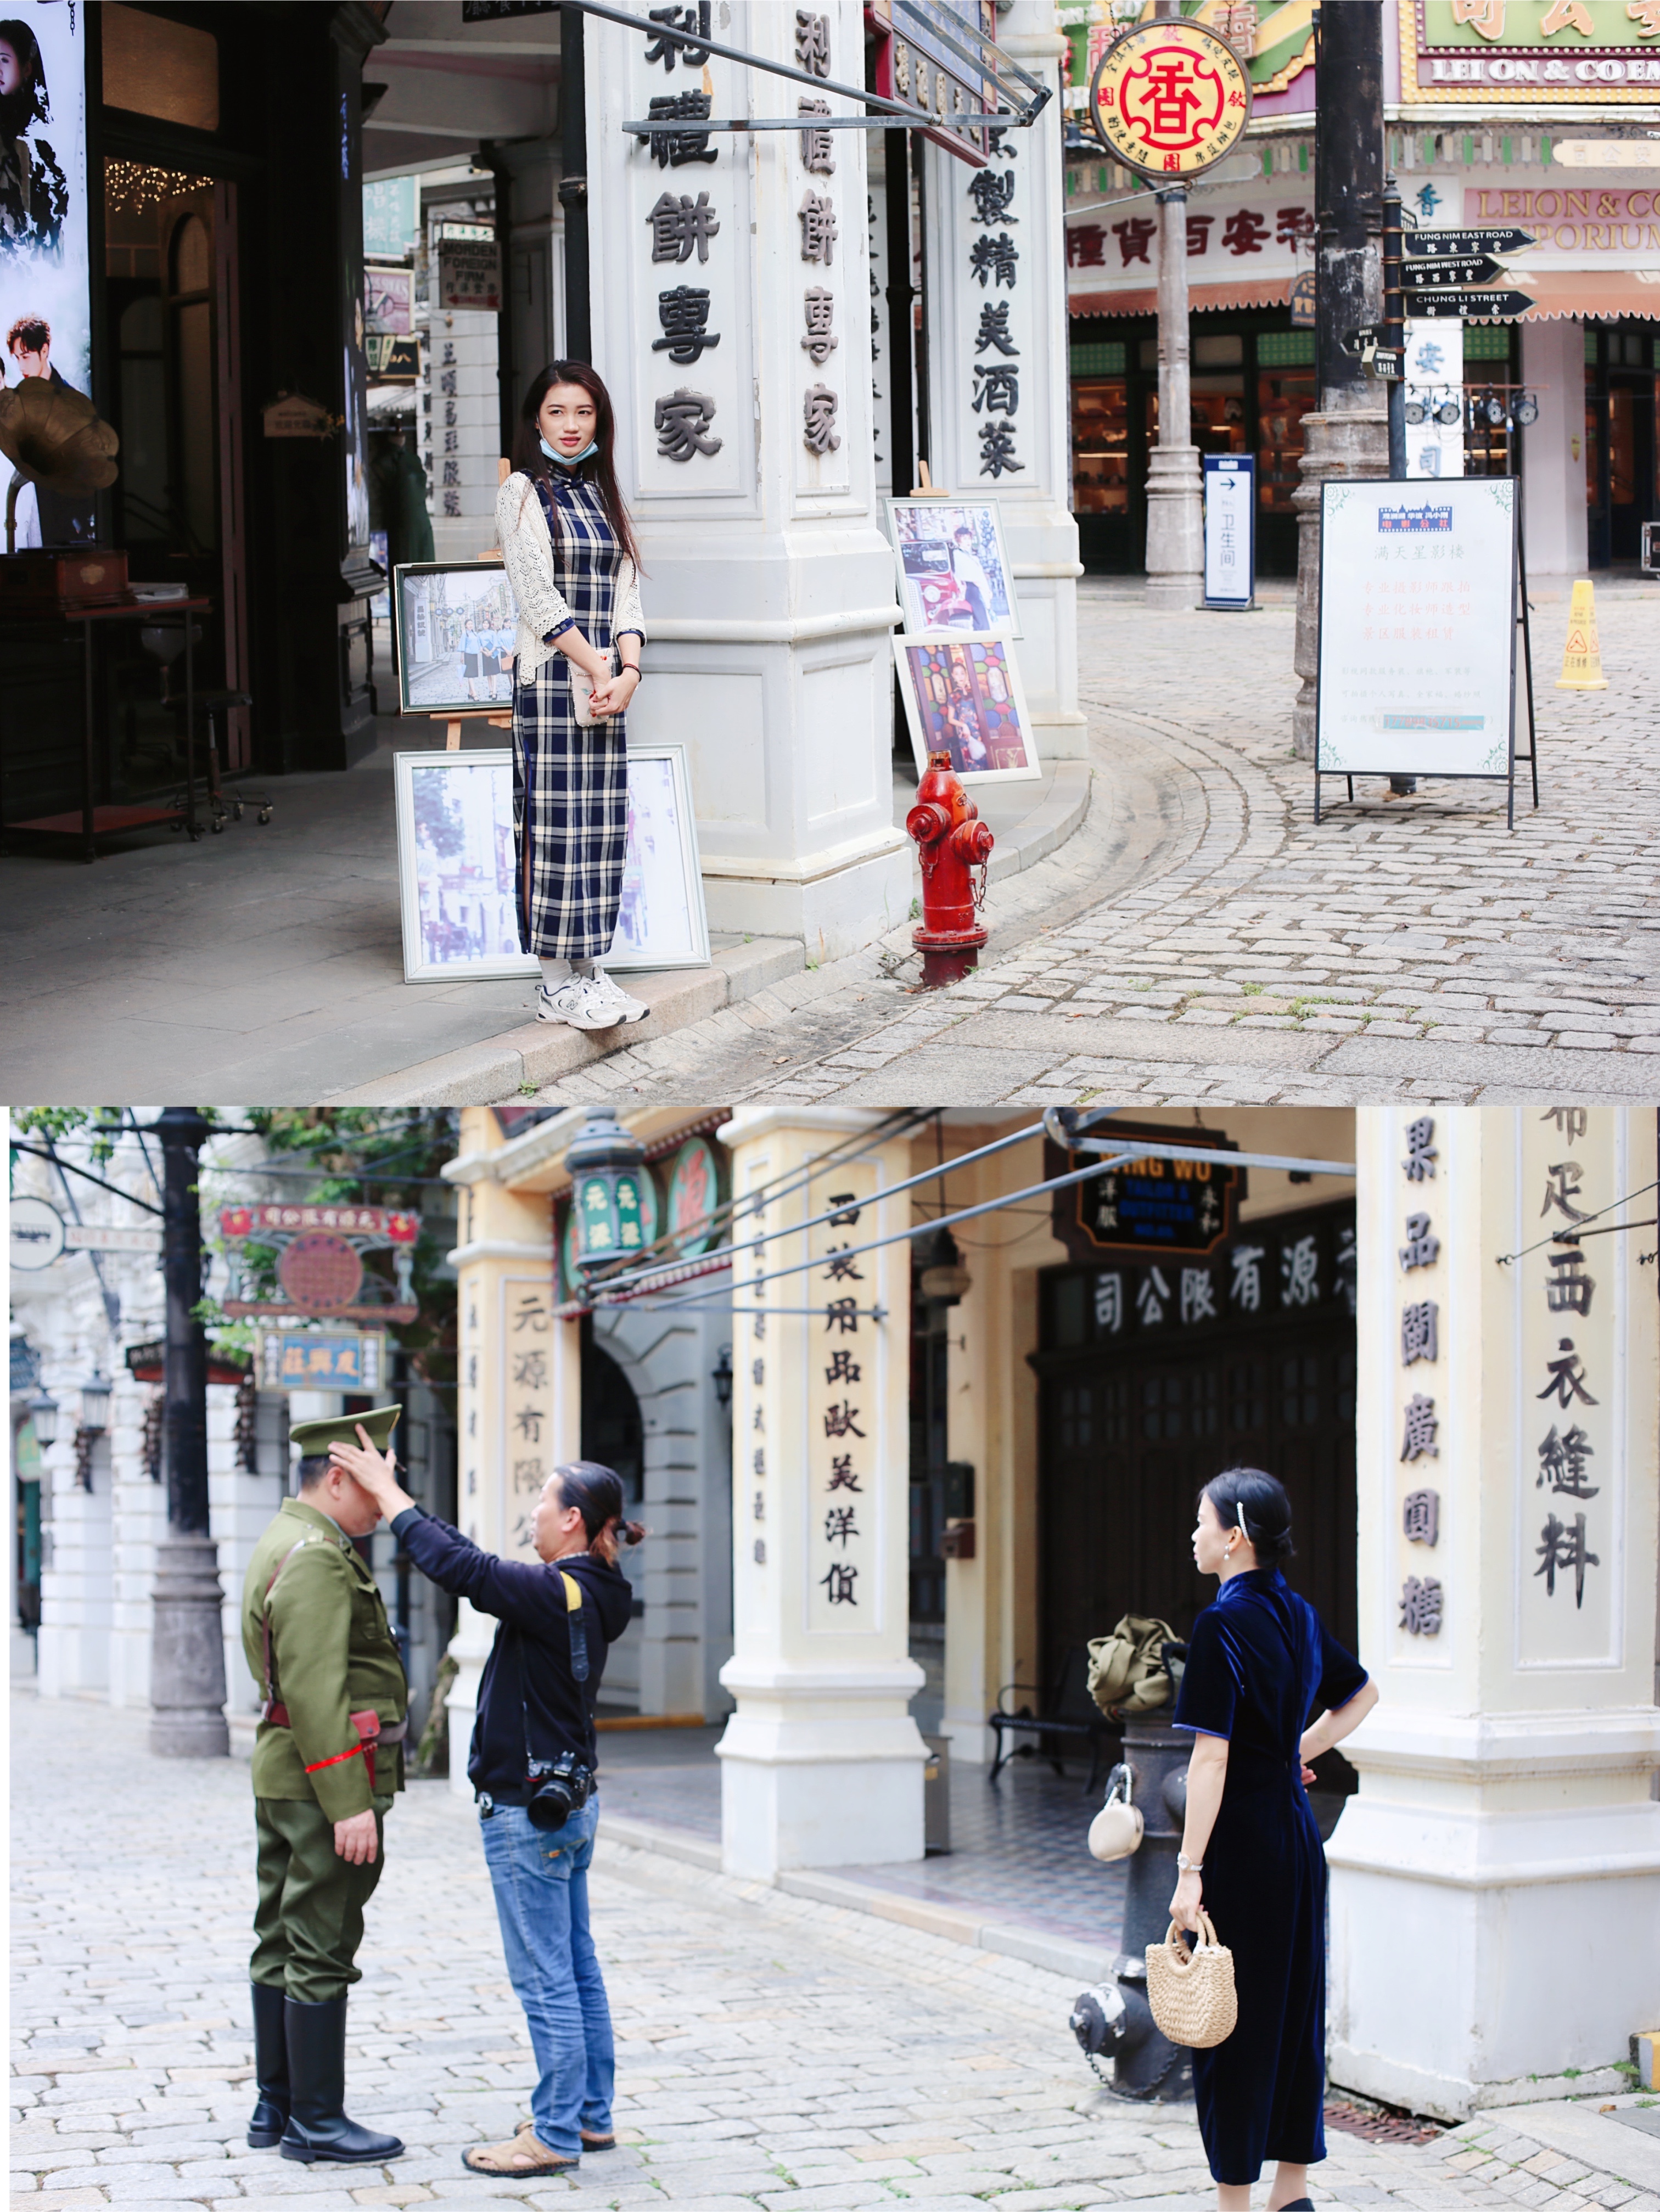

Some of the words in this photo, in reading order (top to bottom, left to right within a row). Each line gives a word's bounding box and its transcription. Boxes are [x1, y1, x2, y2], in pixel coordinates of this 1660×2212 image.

[1431, 59, 1539, 81] LEION
[1544, 60, 1570, 81] &
[1139, 61, 1202, 133] 香
[1414, 183, 1443, 217] 香
[1477, 190, 1590, 218] LEION
[1597, 192, 1622, 218] &
[1628, 190, 1660, 218] C
[1406, 263, 1426, 272] FUNG
[1441, 260, 1460, 269] WEST
[1461, 259, 1483, 267] ROAD
[1221, 514, 1235, 566] 卫生间
[1374, 544, 1465, 560] 满天星影楼
[1362, 580, 1471, 594] 专业摄影师跟拍
[1362, 602, 1471, 617] 专业化妆师造型
[1362, 627, 1455, 641] 景区服装租赁
